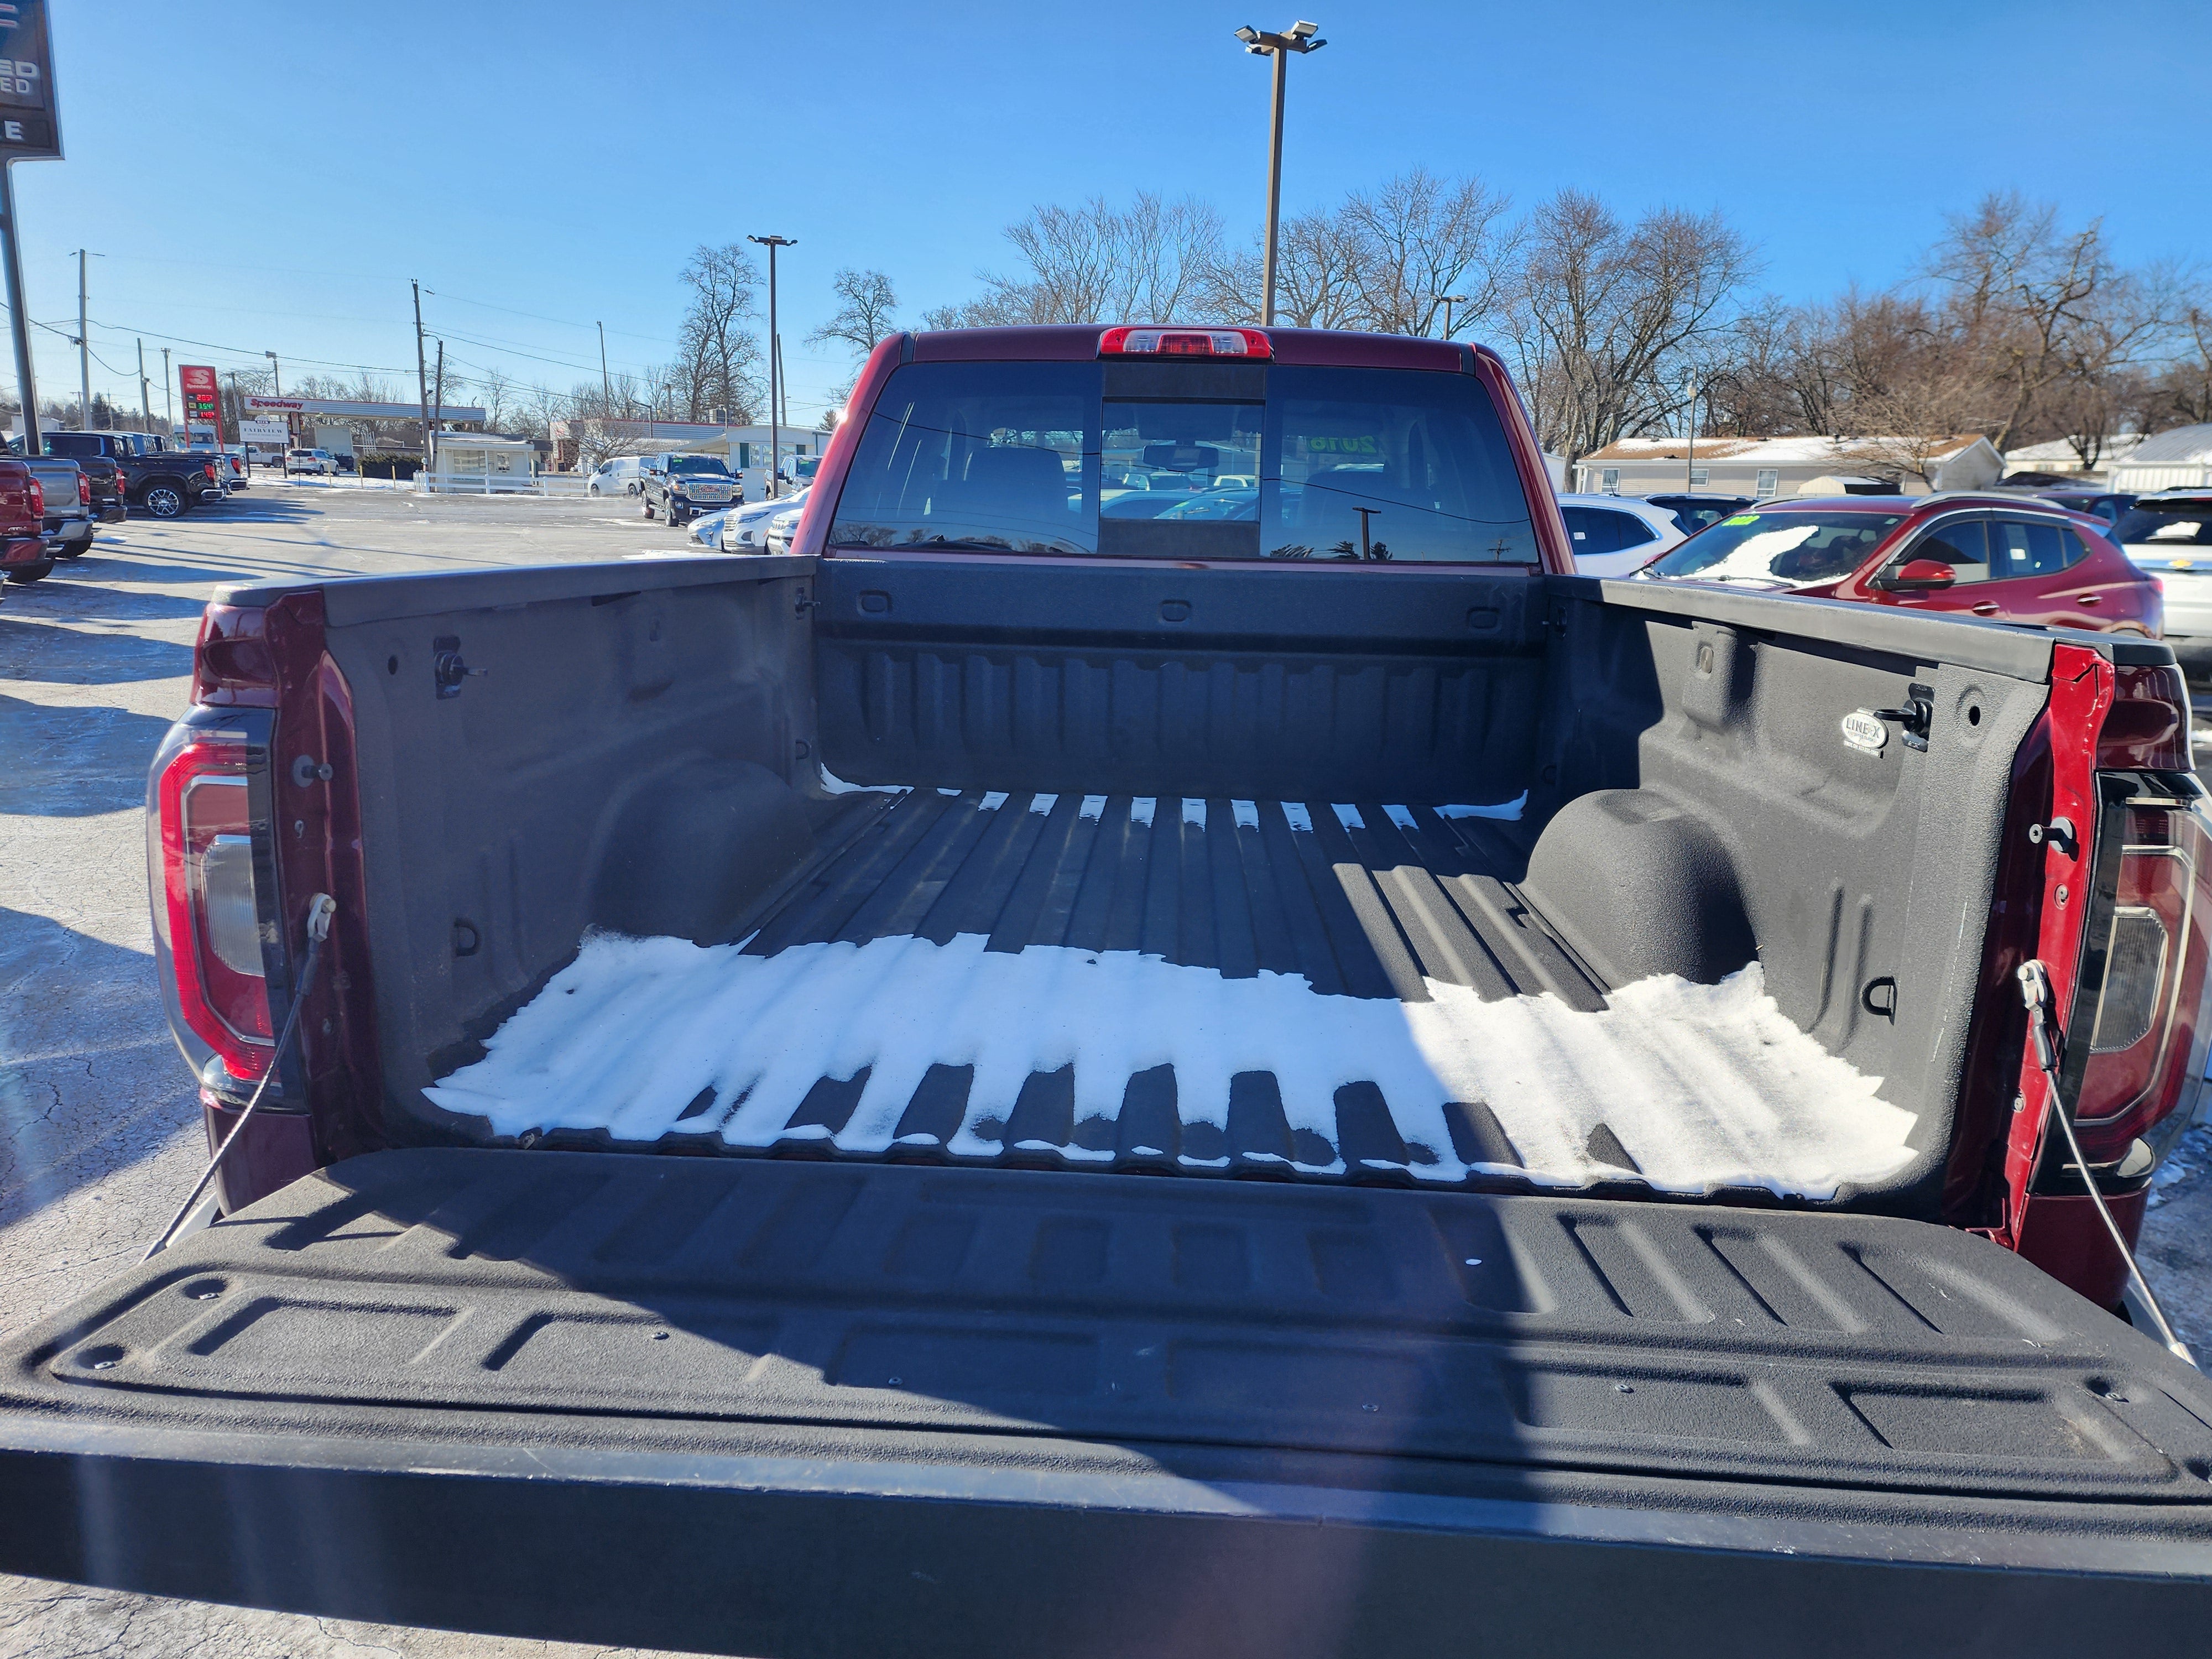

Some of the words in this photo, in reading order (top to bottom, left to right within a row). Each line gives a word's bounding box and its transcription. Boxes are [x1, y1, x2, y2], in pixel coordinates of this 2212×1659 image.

[0, 77, 29, 93] ED
[4, 121, 22, 139] E
[251, 399, 303, 410] Speedway
